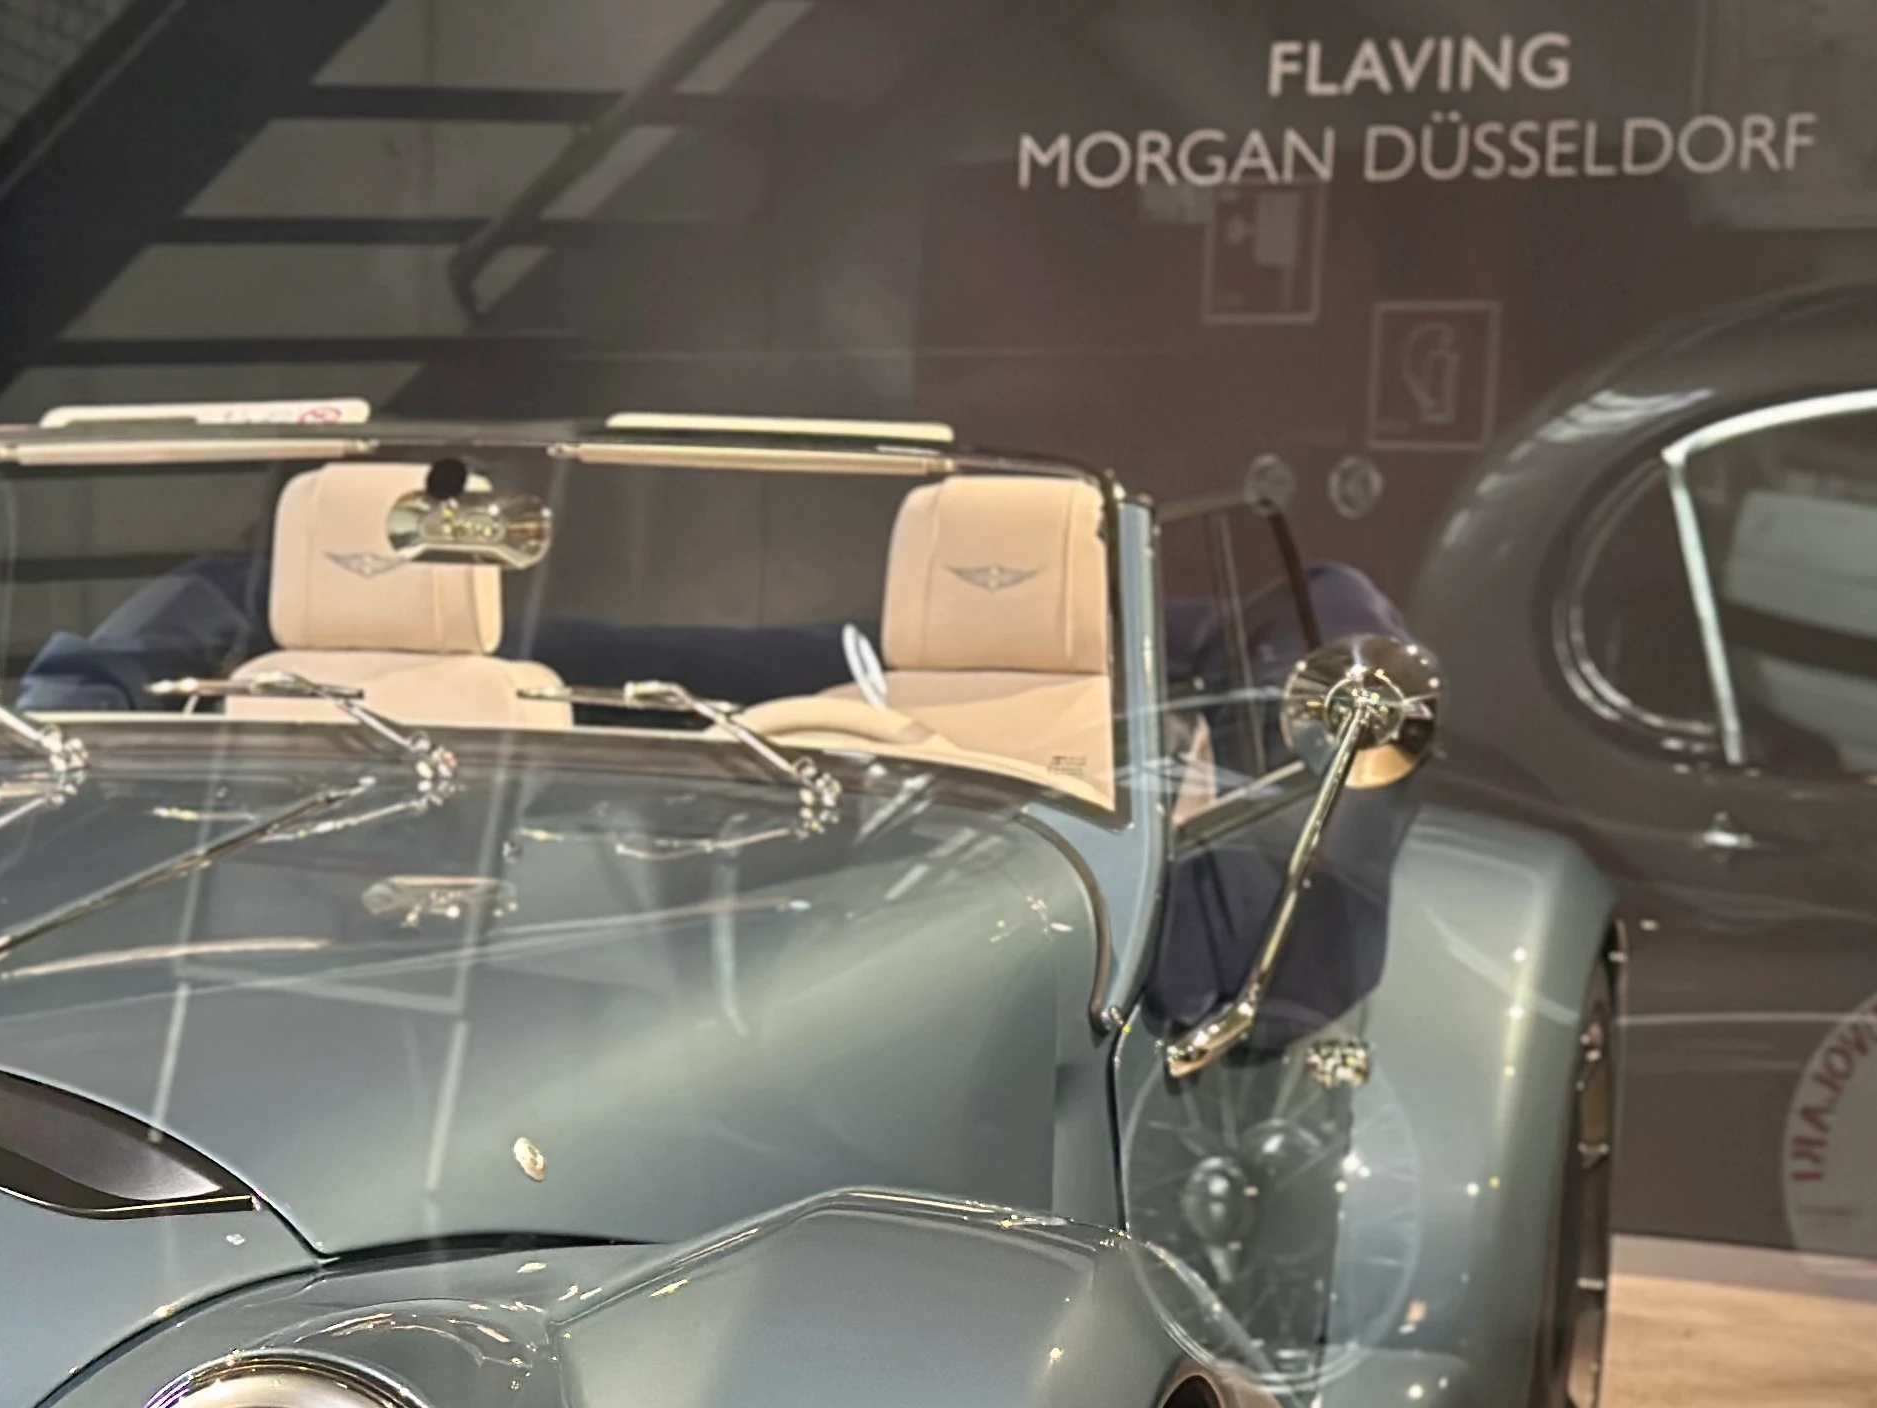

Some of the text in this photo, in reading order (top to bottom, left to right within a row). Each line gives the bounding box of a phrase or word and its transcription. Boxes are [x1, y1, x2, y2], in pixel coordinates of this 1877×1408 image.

[1268, 32, 1571, 97] FLAVING
[1018, 111, 1819, 190] MORGAN DÜSSELDORF
